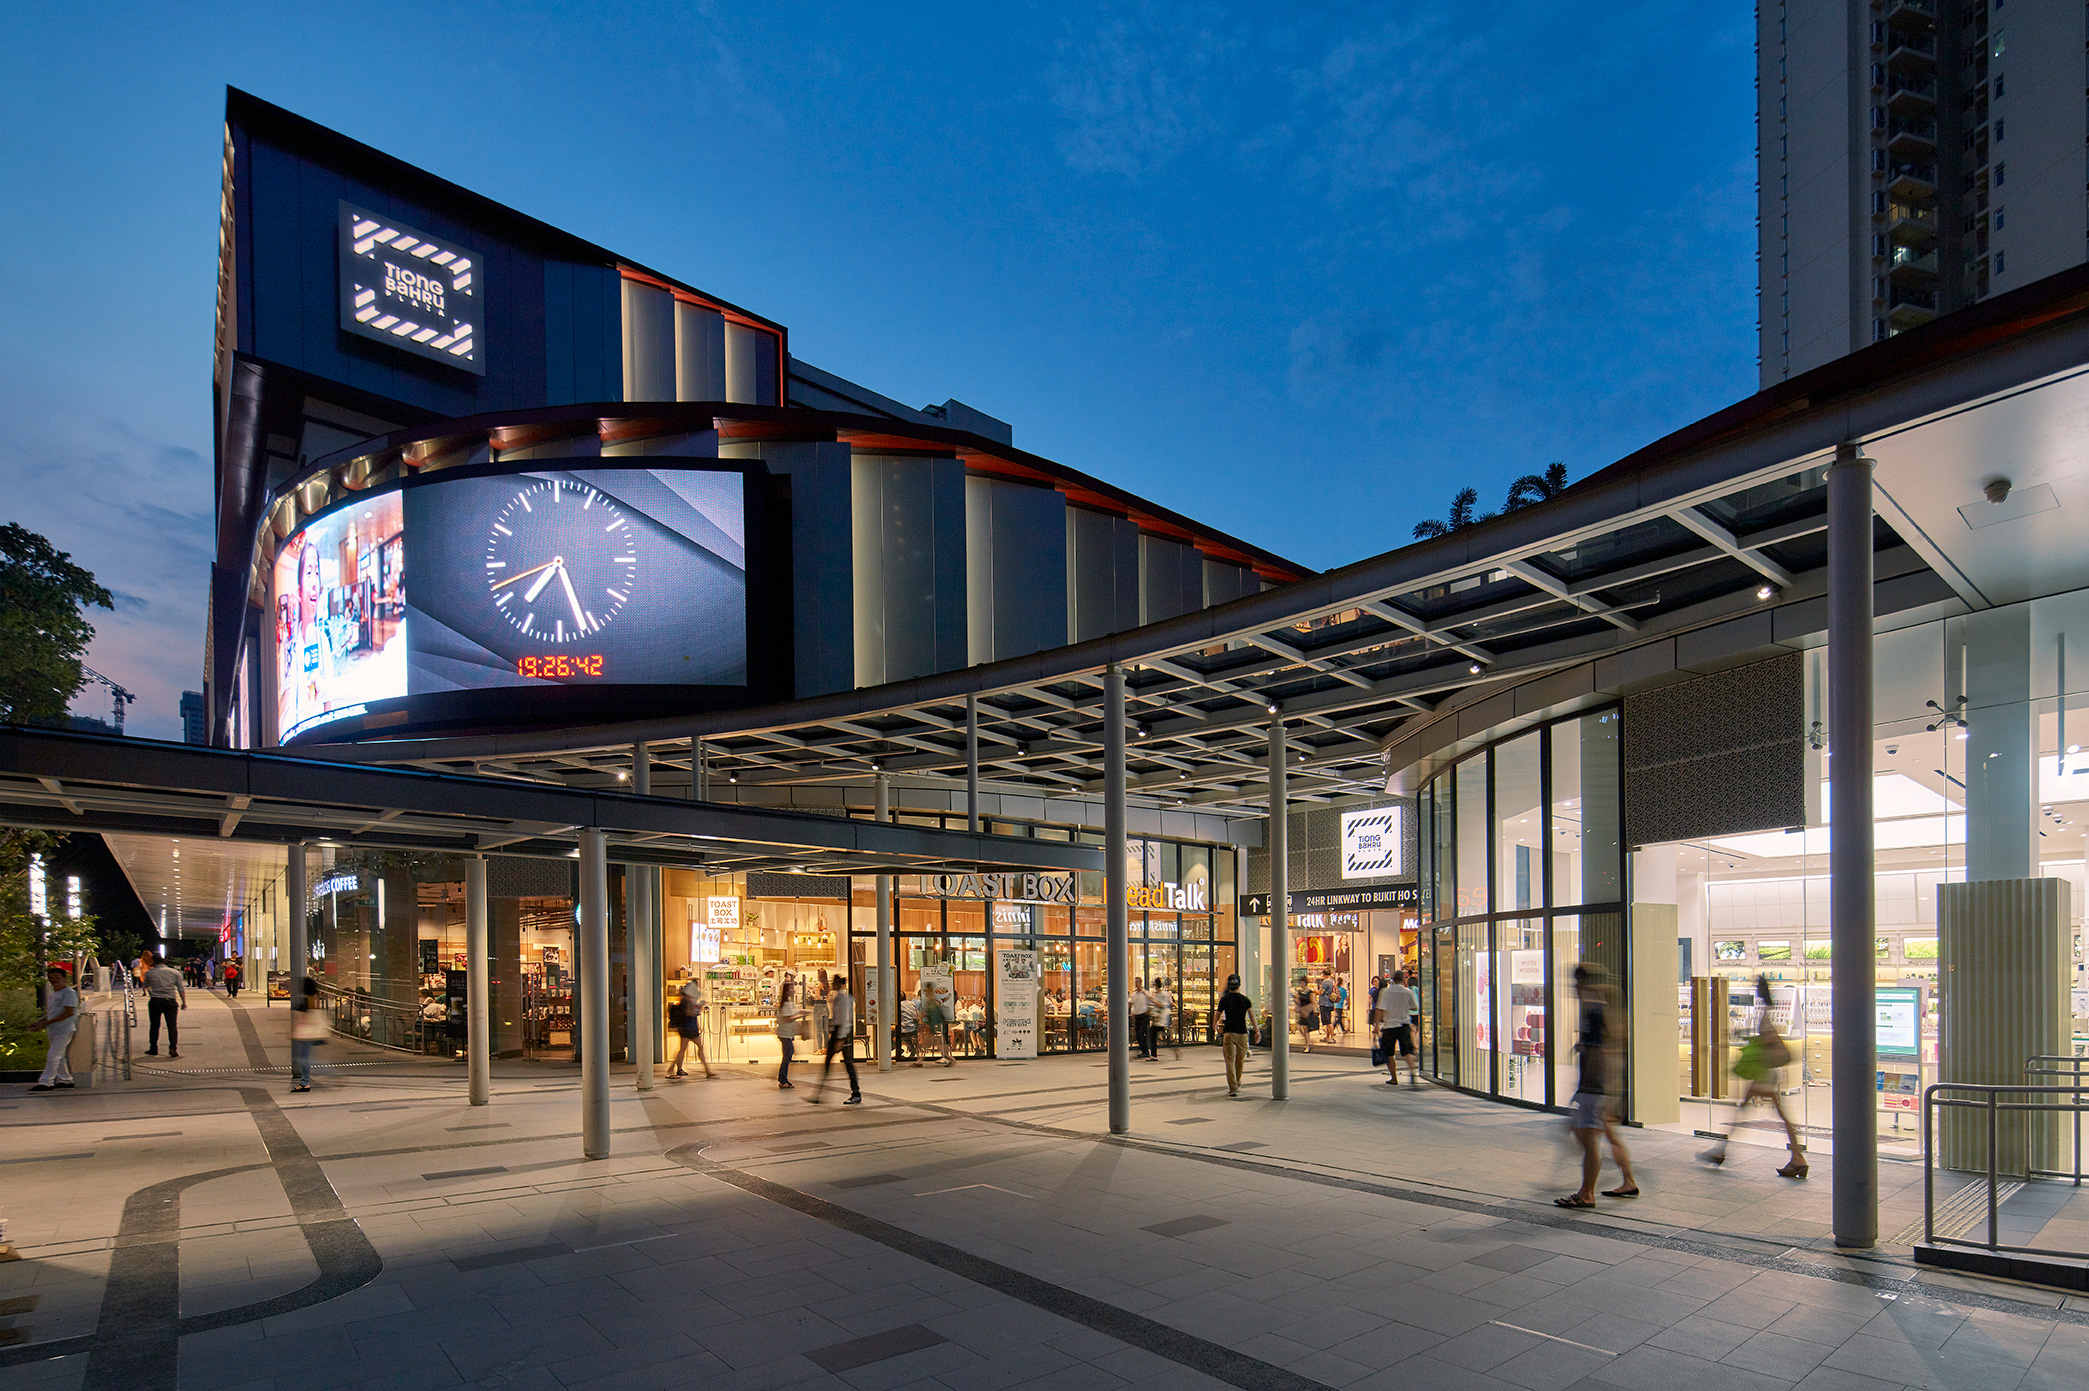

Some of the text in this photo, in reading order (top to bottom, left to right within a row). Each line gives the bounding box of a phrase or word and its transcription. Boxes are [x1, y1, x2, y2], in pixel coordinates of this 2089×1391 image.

[385, 290, 445, 317] PLAZA
[518, 654, 603, 678] 19:26:42
[331, 875, 358, 892] COFFEE
[1023, 873, 1075, 902] BOX
[709, 900, 737, 908] TOAST
[1306, 896, 1326, 907] 24HR
[1327, 893, 1361, 905] LINKWAY
[1361, 892, 1372, 903] TO
[1373, 890, 1397, 902] BUKIT
[1397, 889, 1411, 901] HO
